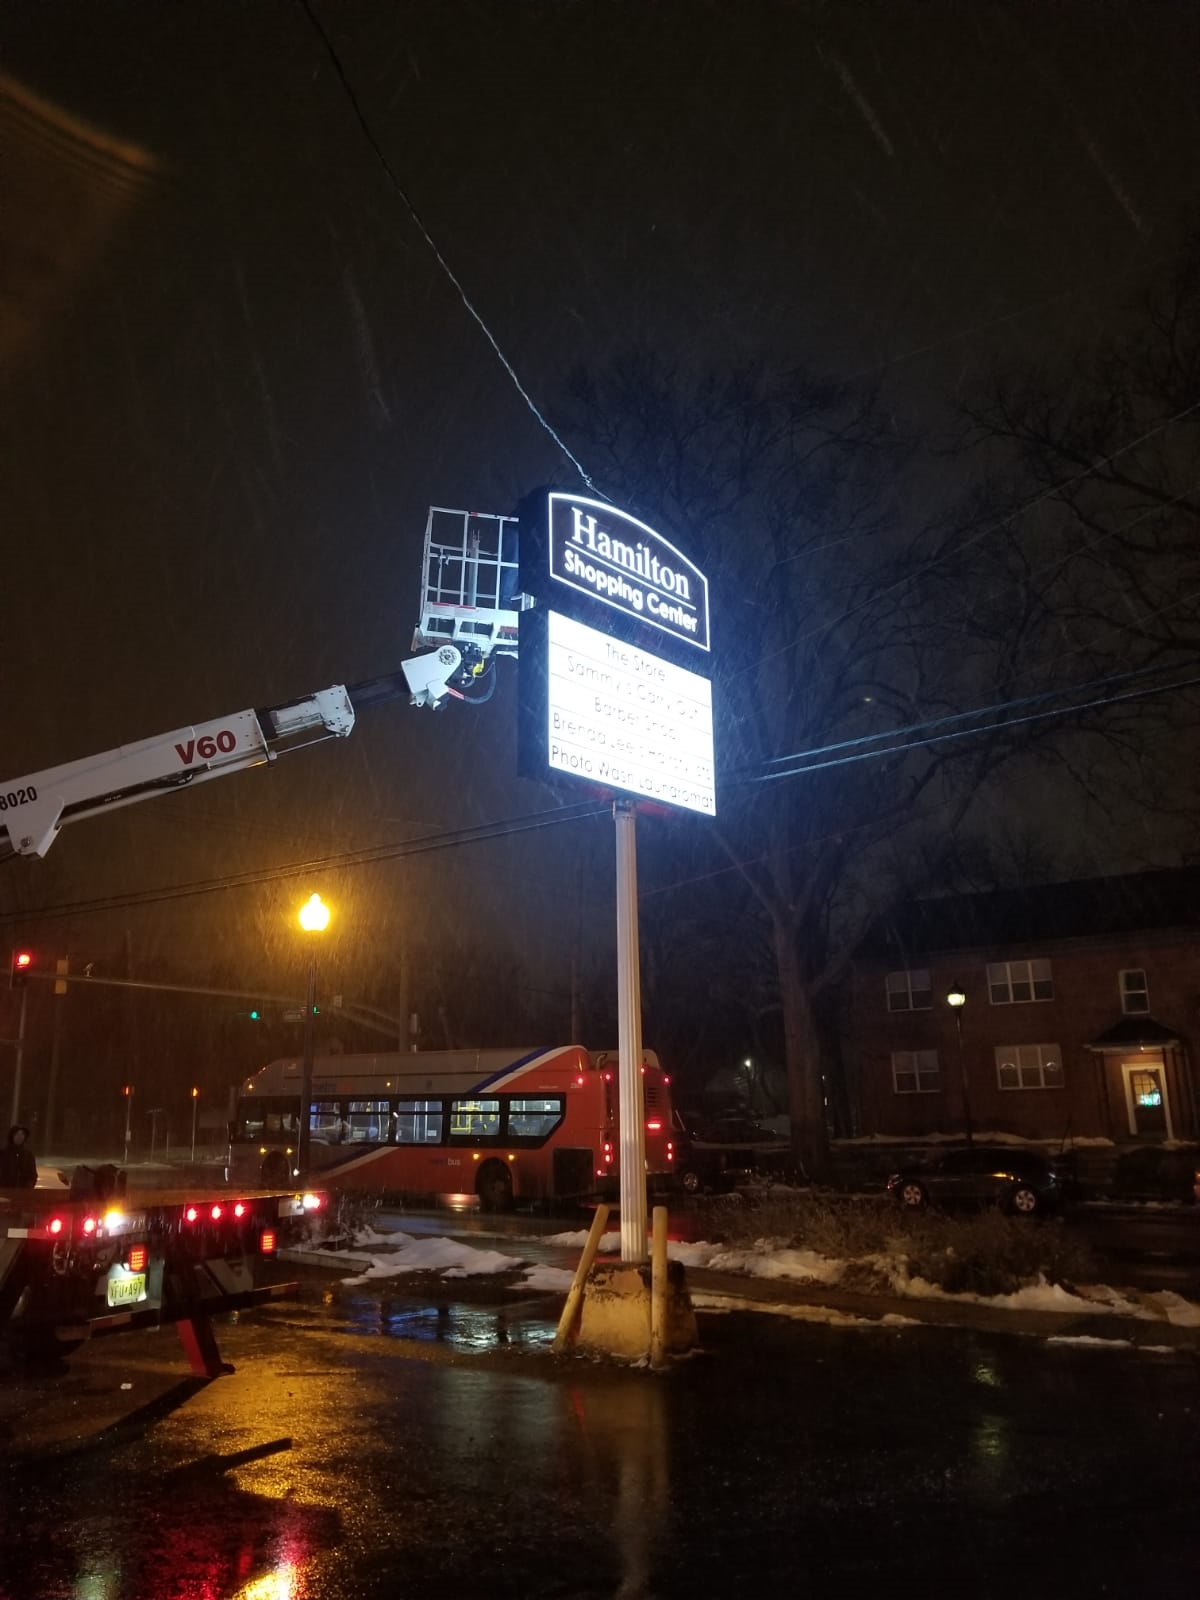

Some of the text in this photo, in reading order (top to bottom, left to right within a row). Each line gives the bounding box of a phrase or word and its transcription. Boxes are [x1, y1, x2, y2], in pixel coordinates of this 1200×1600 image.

[571, 507, 690, 599] Hamilton
[564, 550, 698, 632] Shopping Center
[605, 643, 665, 681] The Store
[175, 730, 236, 765] V60
[553, 712, 606, 745] Brenda
[552, 745, 593, 772] Photo
[599, 761, 635, 783] Wash
